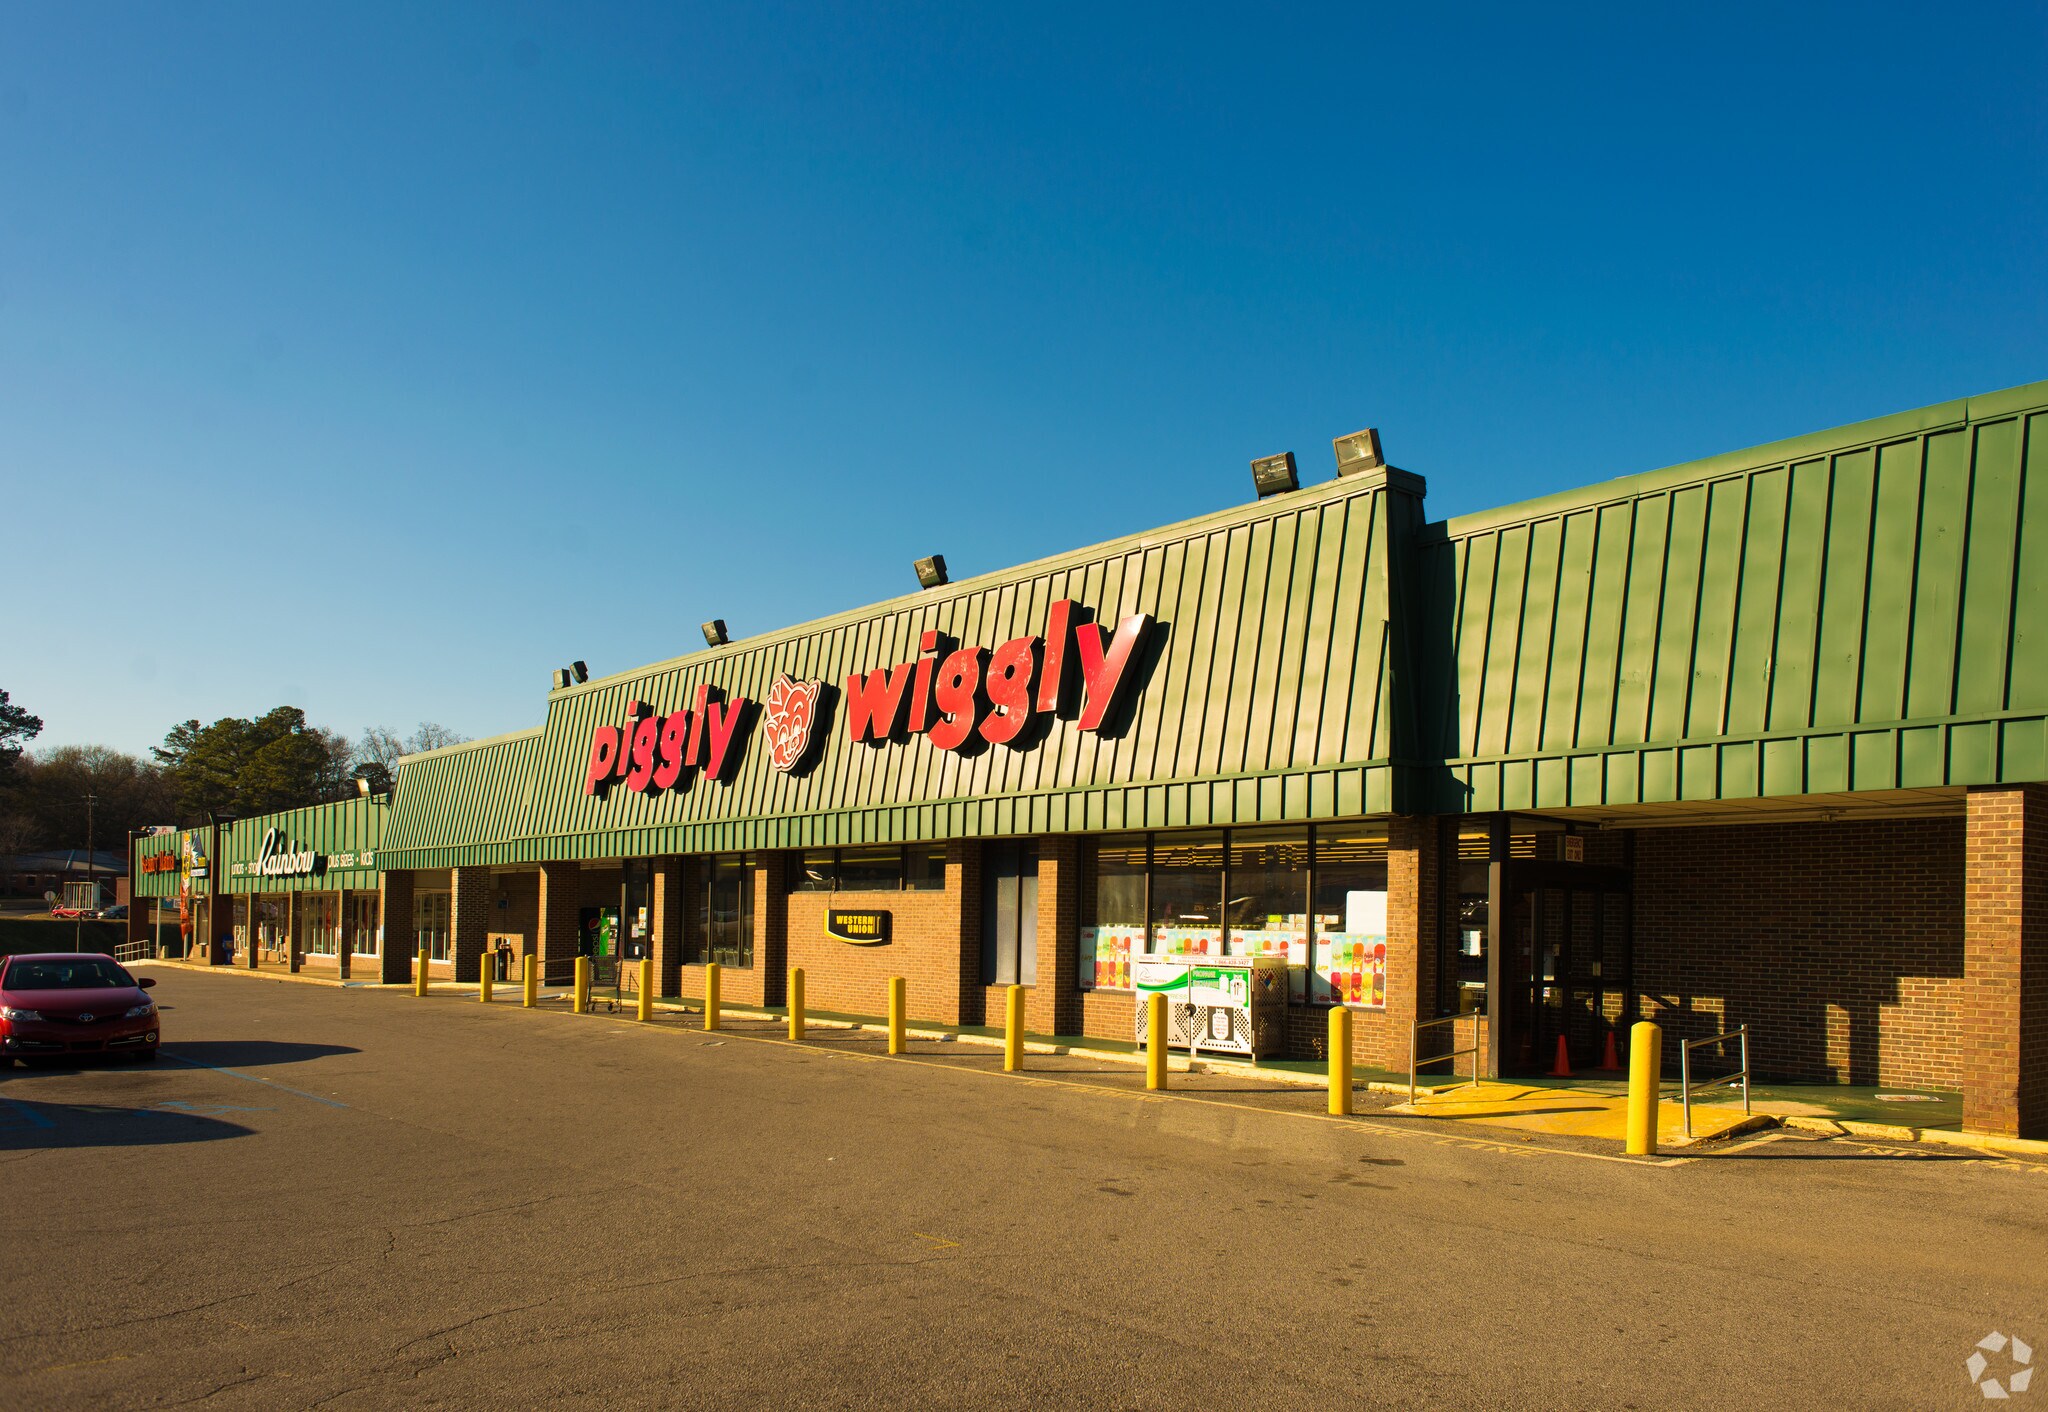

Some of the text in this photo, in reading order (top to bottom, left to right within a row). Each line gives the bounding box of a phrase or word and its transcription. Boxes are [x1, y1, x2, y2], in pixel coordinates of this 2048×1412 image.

[586, 599, 1149, 795] piggly wiggly
[257, 827, 316, 875] Rainbow
[328, 849, 374, 868] plus sizes kids
[836, 915, 874, 925] WESTERN
[847, 924, 873, 934] UNION
[1333, 1124, 1550, 1158] FIRE LANE
